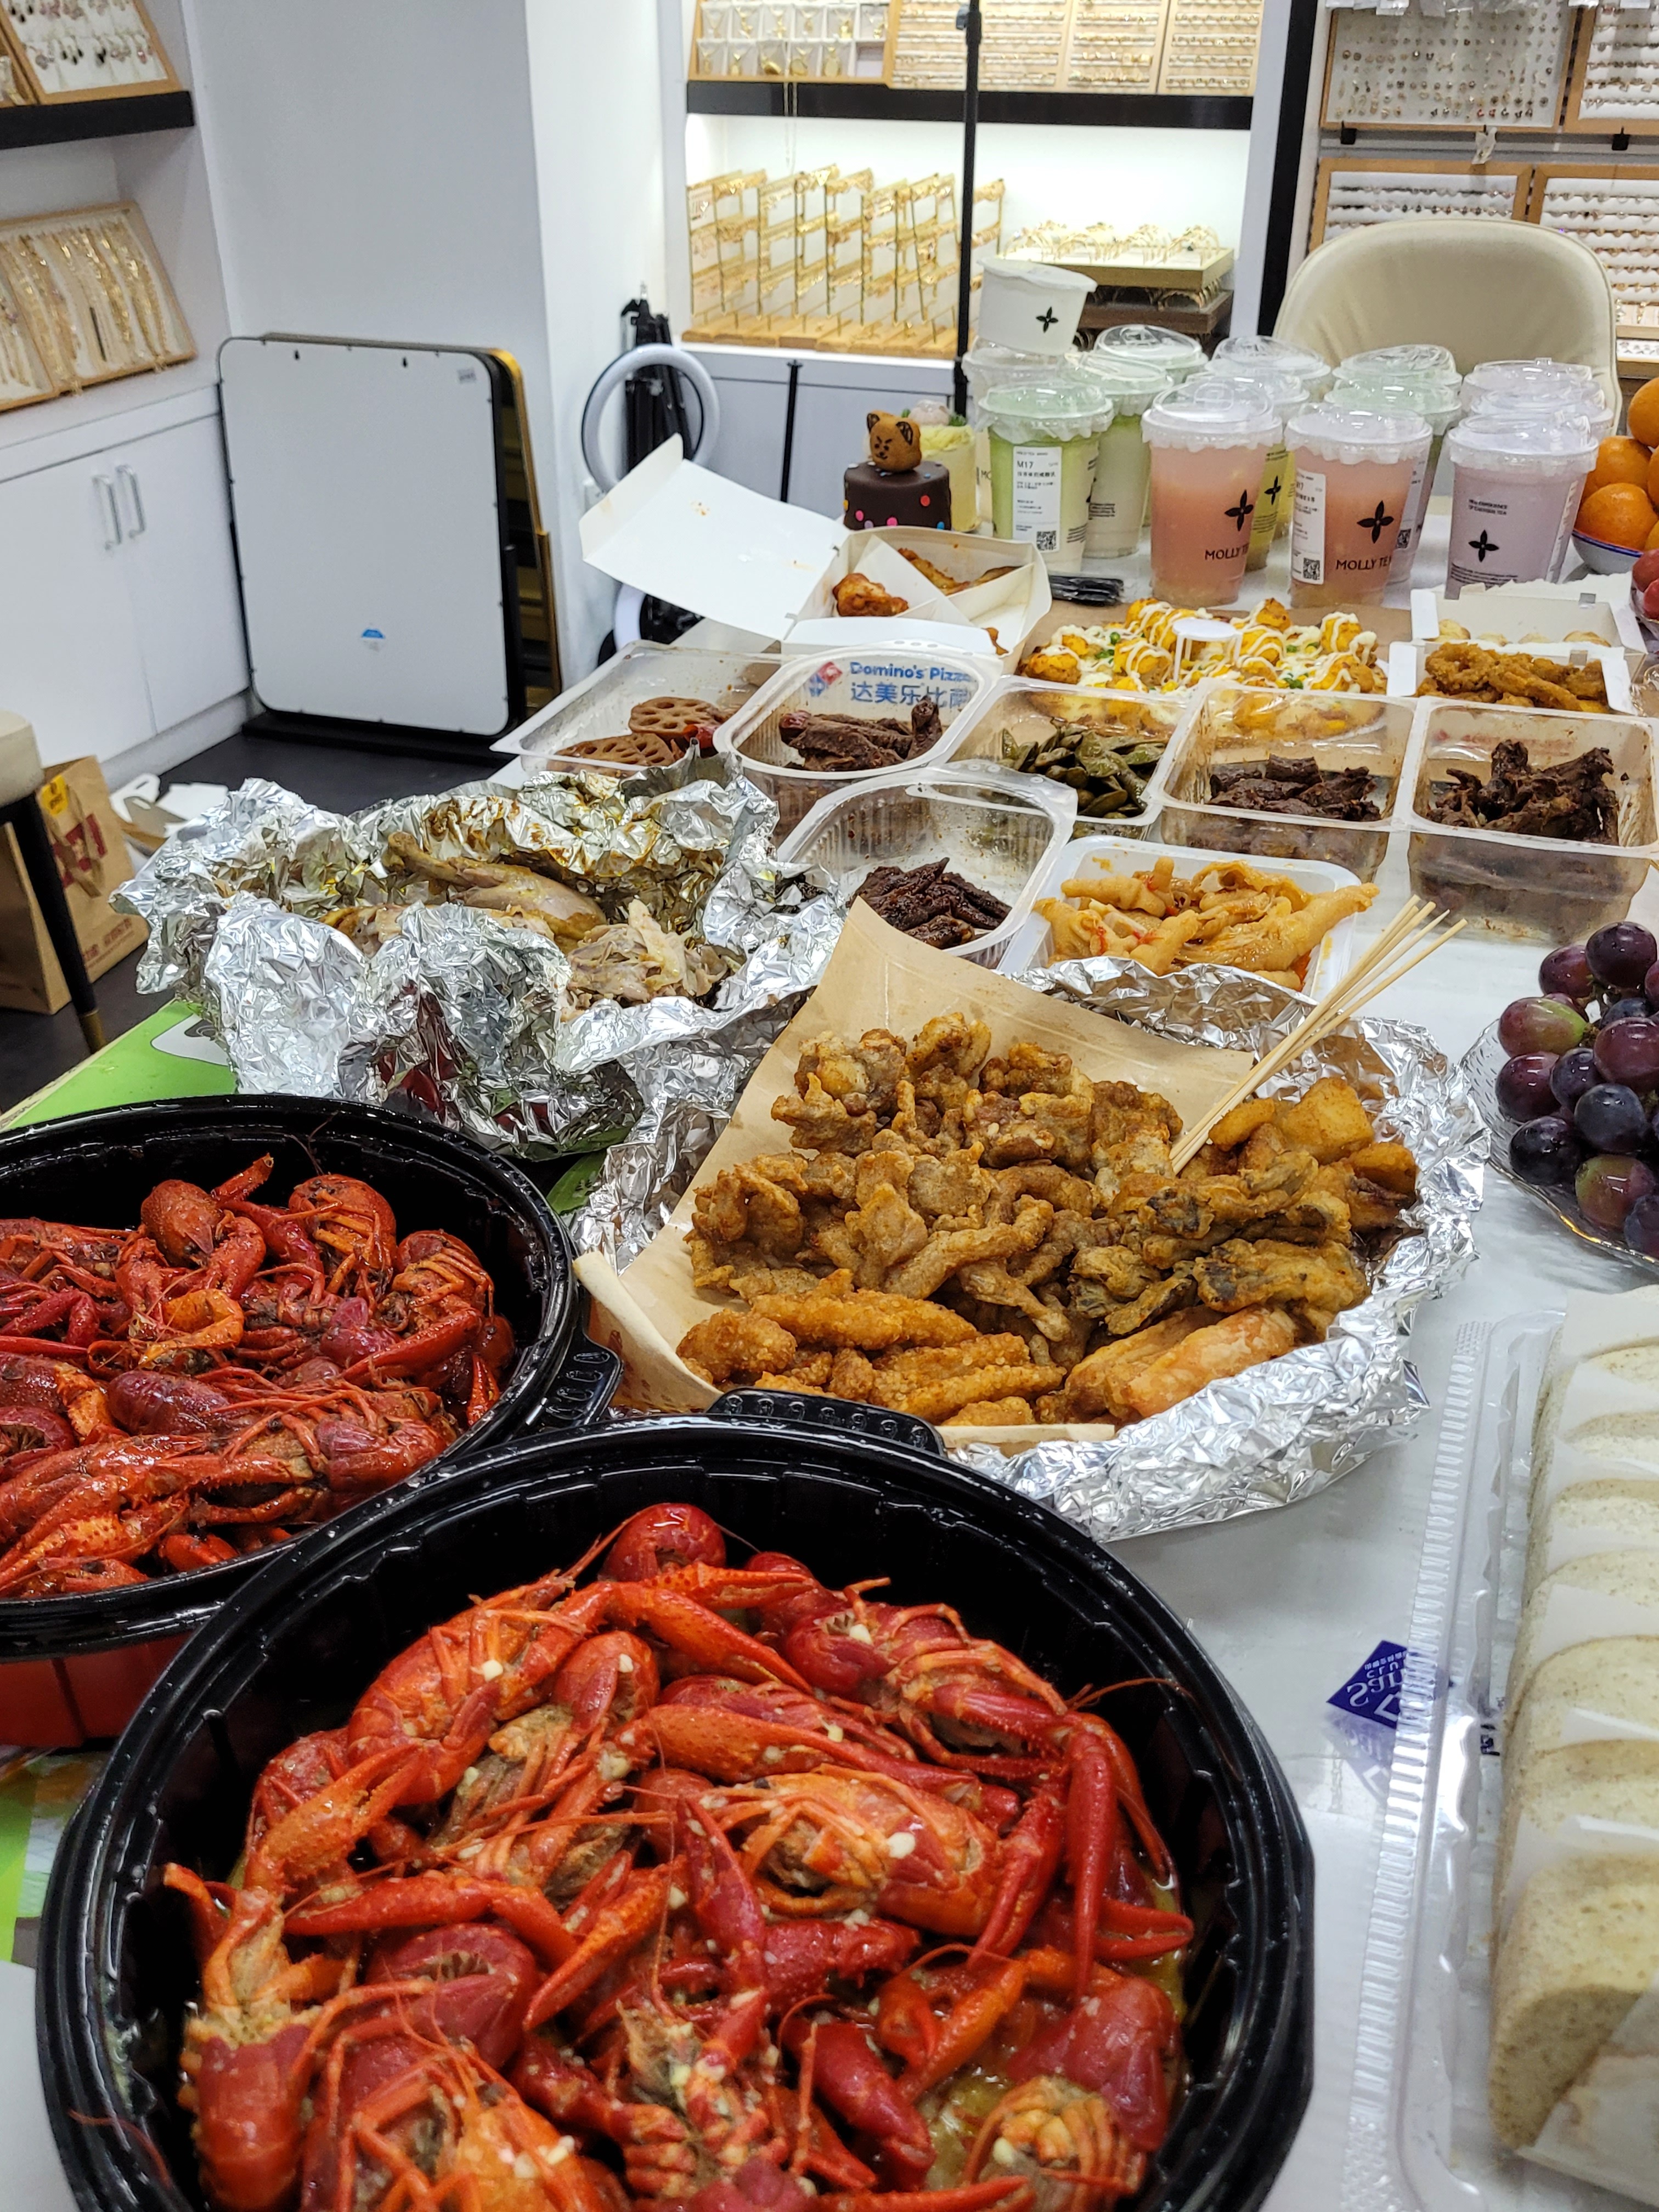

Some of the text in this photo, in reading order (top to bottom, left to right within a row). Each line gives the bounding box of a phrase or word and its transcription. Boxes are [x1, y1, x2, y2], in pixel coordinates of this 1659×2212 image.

[1205, 546, 1241, 560] MOLLY
[1335, 558, 1377, 571] MOLLY
[850, 662, 924, 679] Domino's
